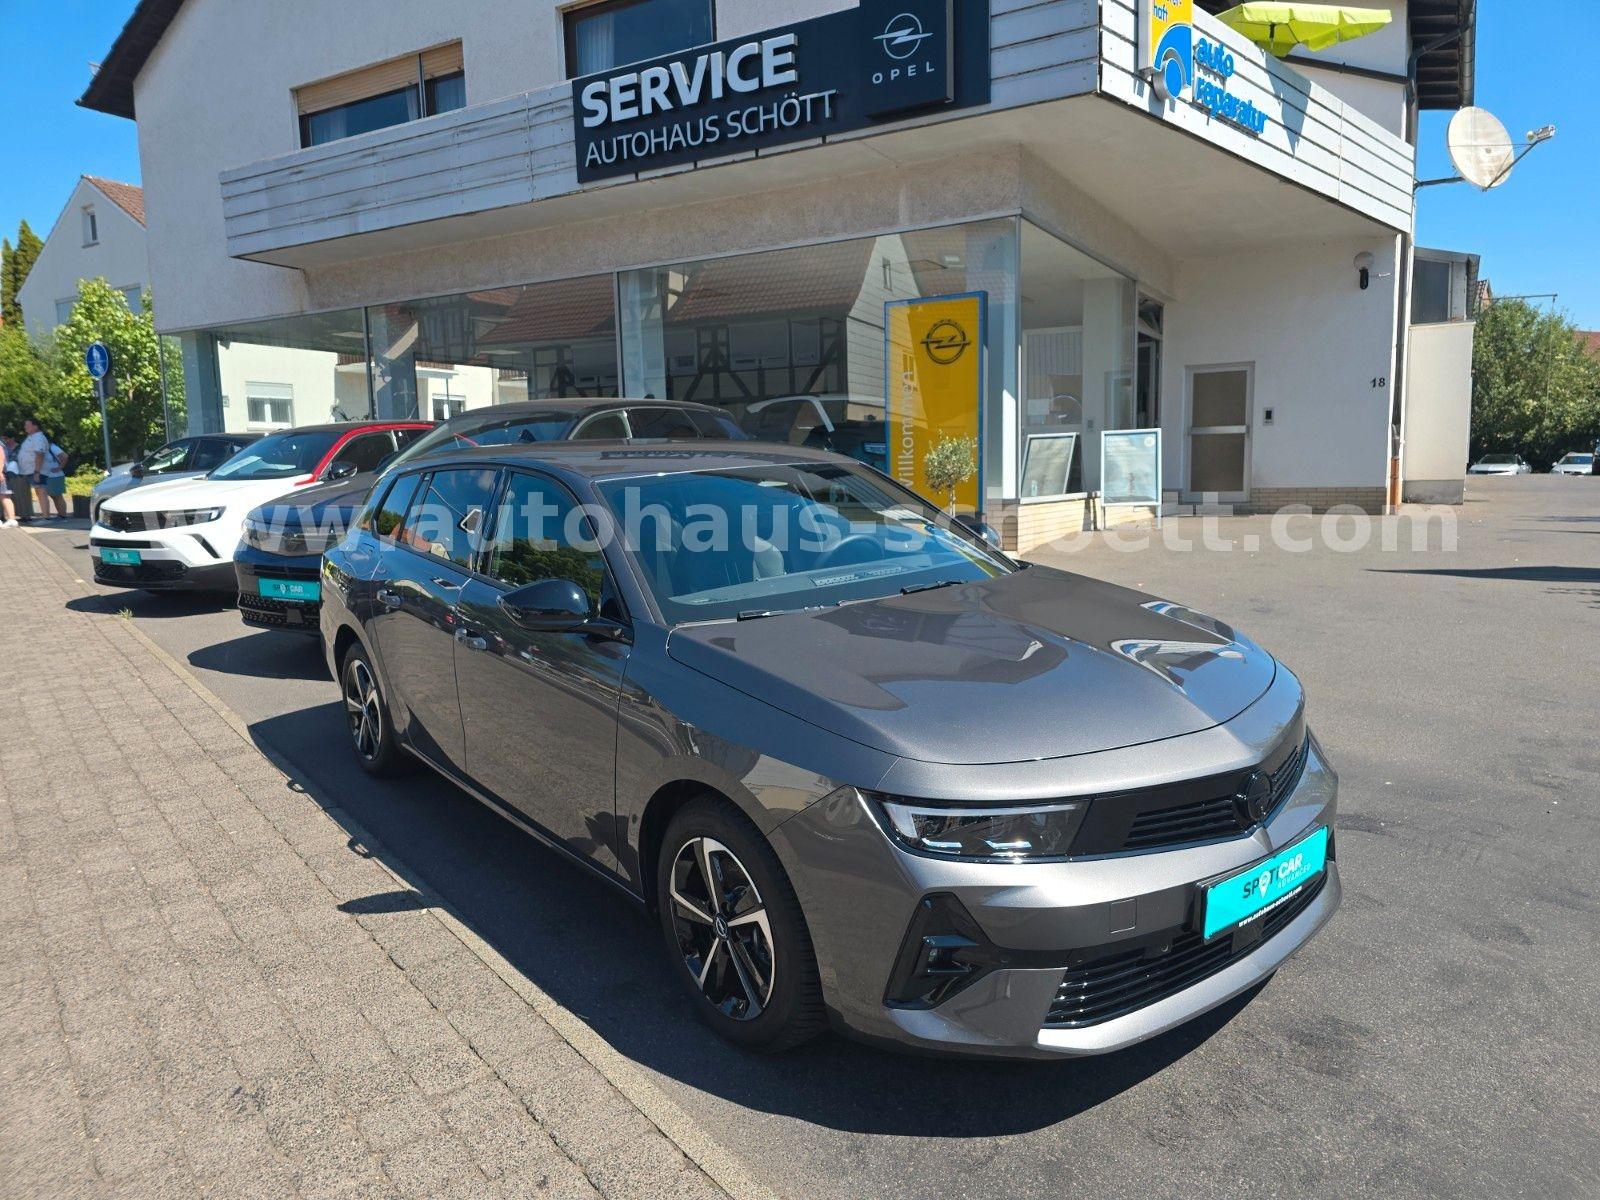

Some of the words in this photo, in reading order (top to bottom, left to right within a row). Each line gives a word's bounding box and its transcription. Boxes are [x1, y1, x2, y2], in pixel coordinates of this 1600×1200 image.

[581, 33, 798, 128] SERVICE
[872, 61, 935, 84] OPEL
[1197, 37, 1234, 77] auto
[585, 115, 720, 168] AUTOHAUS
[727, 89, 837, 138] SCHÖTT
[1196, 77, 1269, 133] reparatur
[1370, 377, 1386, 388] 18
